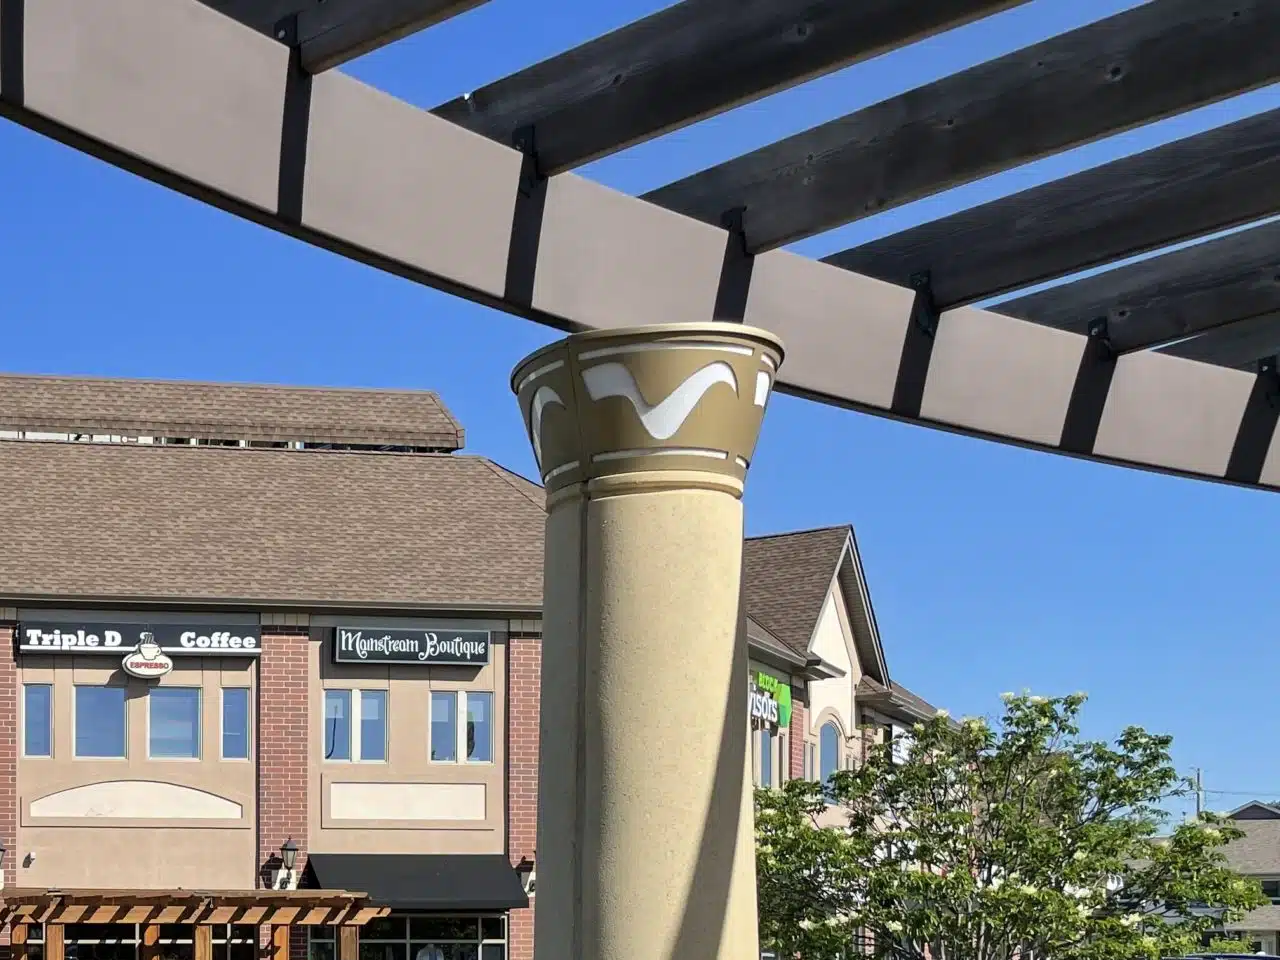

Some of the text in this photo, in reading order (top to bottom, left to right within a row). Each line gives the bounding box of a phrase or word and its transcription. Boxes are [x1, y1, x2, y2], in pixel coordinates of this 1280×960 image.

[26, 629, 122, 650] Triple D
[180, 631, 257, 648] Coffee
[341, 630, 485, 661] Mainstream Boutique
[130, 661, 169, 670] ESPRESSO
